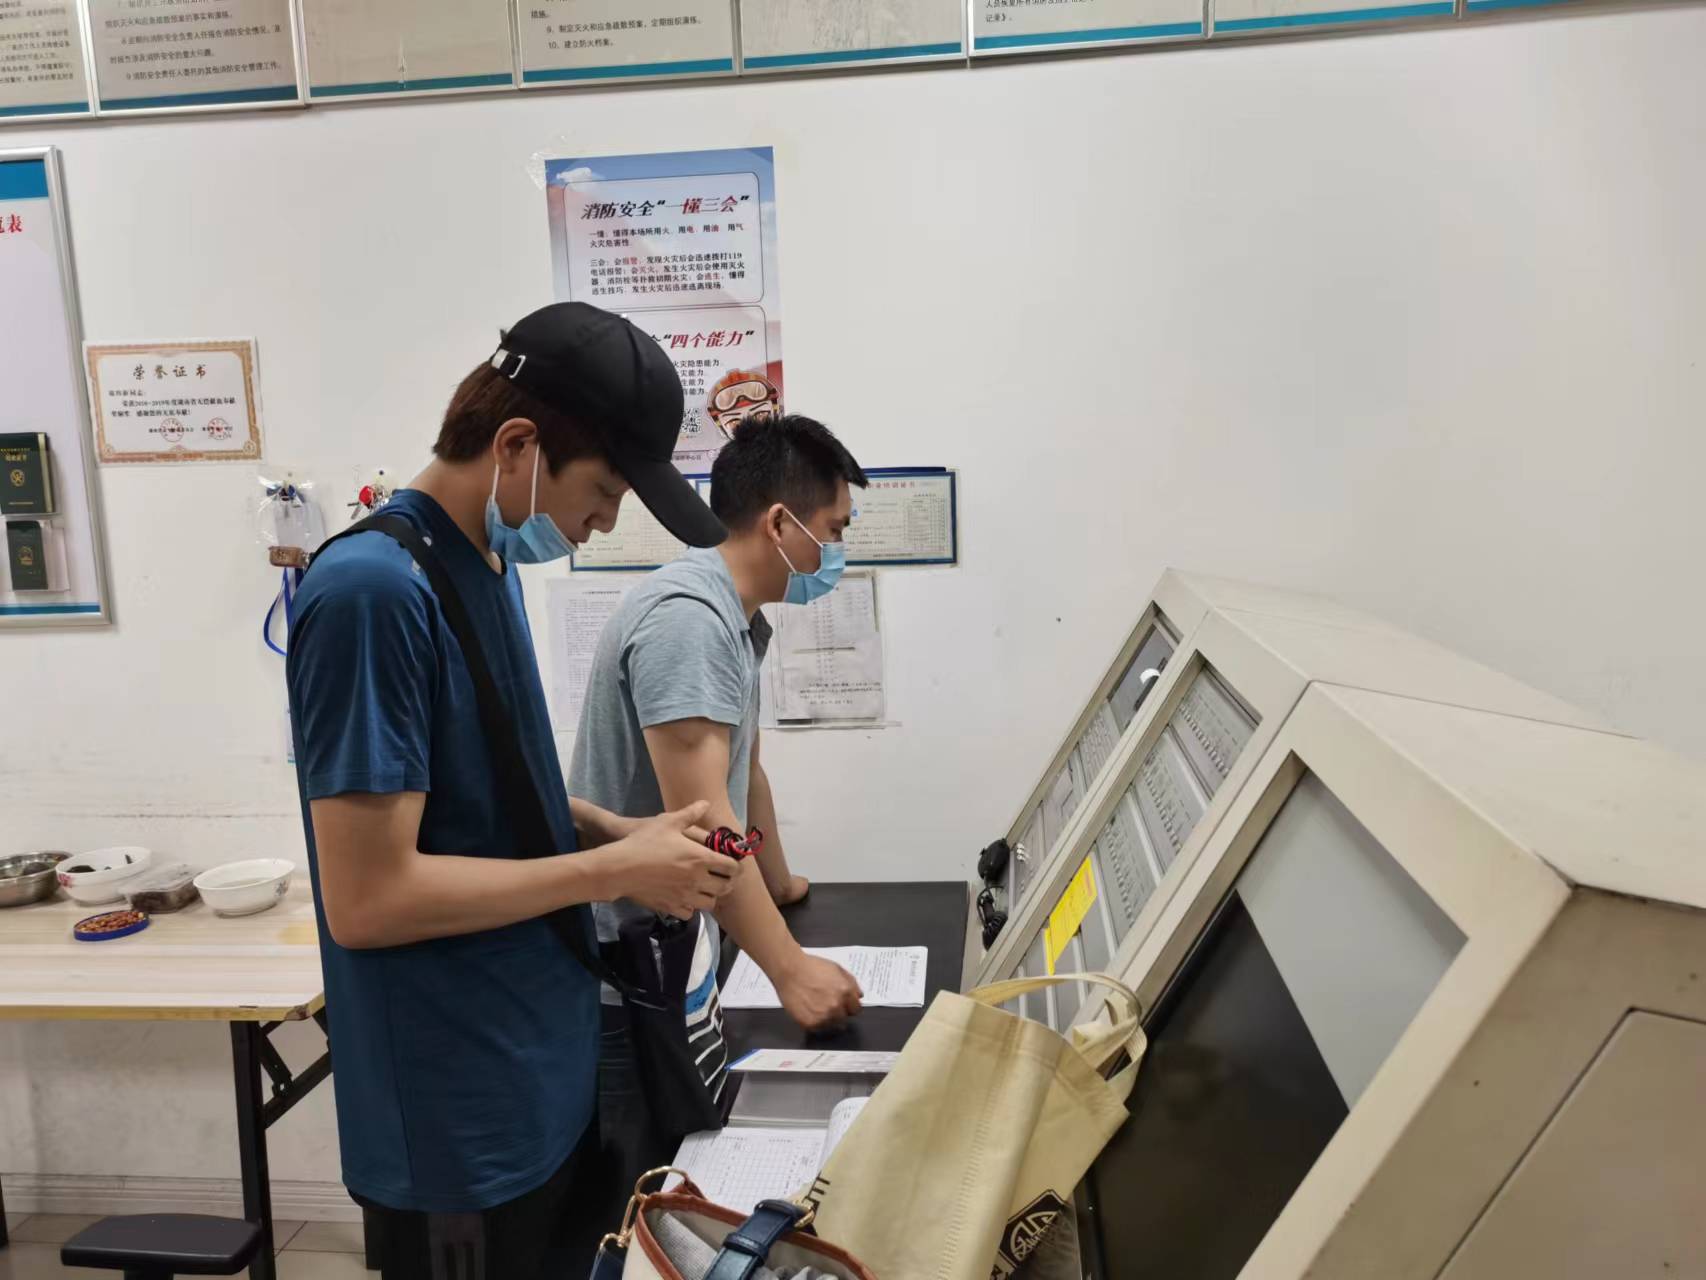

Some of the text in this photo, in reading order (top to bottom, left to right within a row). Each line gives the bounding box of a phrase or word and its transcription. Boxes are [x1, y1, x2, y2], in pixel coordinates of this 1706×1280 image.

[0, 213, 22, 233] 表
[651, 329, 755, 350] “四个能力”
[132, 363, 208, 381] 荣誉证书
